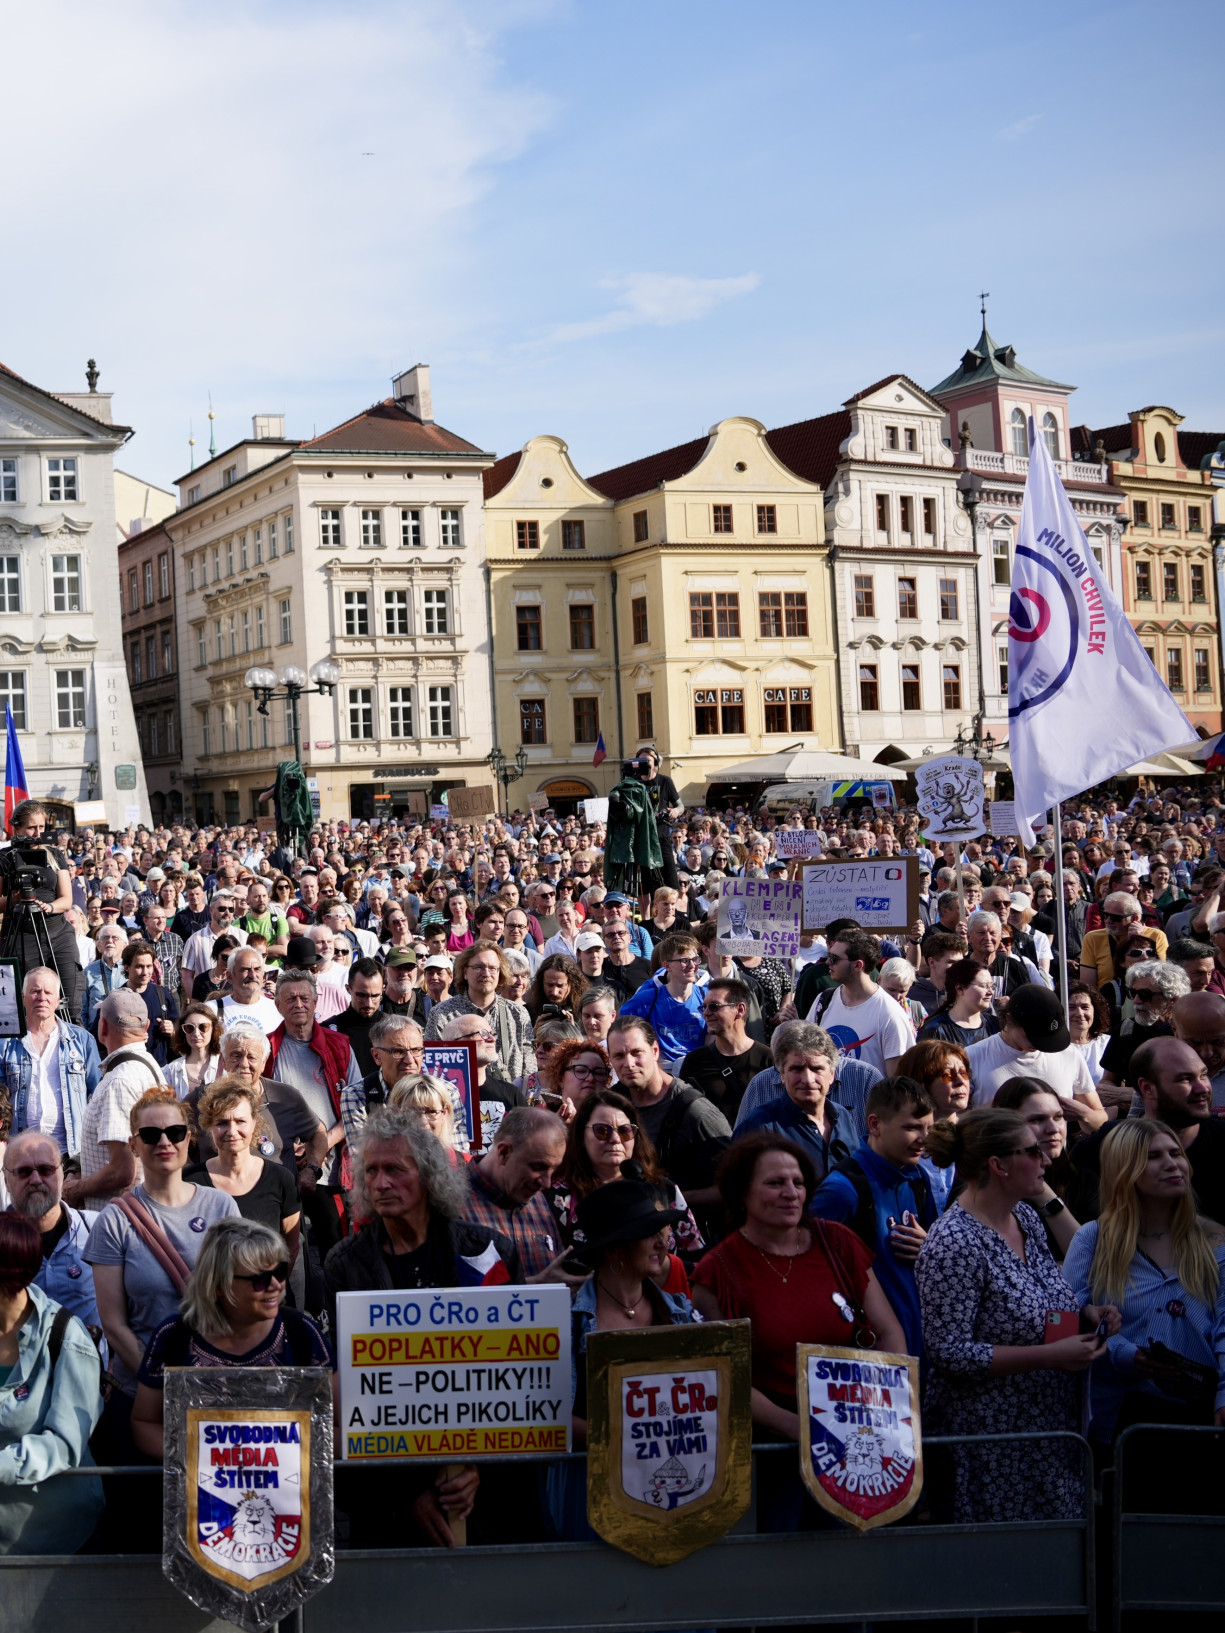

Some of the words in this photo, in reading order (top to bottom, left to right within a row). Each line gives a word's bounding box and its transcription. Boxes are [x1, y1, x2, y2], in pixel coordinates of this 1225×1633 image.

[1036, 528, 1088, 578] MILION
[1080, 577, 1106, 655] CHVILEK
[695, 690, 742, 703] CAFE
[764, 689, 810, 701] CAFE
[372, 767, 440, 778] STARBUCKS
[809, 866, 882, 884] ZŮSTAT
[722, 881, 803, 899] KLEMPÍŘ
[760, 931, 800, 942] AGENT
[434, 1050, 464, 1064] PRYČ
[369, 1302, 422, 1327] PRO
[429, 1296, 480, 1325] ČRo
[486, 1306, 500, 1323] a
[507, 1293, 540, 1322] ČT
[352, 1334, 484, 1362] POPLATKY
[506, 1332, 561, 1357] ANO
[360, 1372, 393, 1396] NE
[626, 1380, 660, 1418] ČT
[671, 1377, 718, 1414] ČRo
[348, 1406, 365, 1428] A
[370, 1403, 448, 1426] JEJICH
[456, 1395, 562, 1424] PIKOLÍKY
[204, 1422, 301, 1445] SVOBODNÁ
[631, 1416, 704, 1440] STOJÍME
[348, 1431, 410, 1455] MÉDIA
[413, 1428, 478, 1452] VLÁDĚ
[484, 1426, 567, 1450] NEDÁME
[635, 1440, 662, 1460] ZA
[666, 1434, 708, 1457] VÁMI
[210, 1444, 280, 1467] MÉDIA
[214, 1466, 280, 1489] ŠTÍTEM
[811, 1442, 914, 1497] DEMOKRACIE
[198, 1521, 302, 1564] DEMOKRACIE
